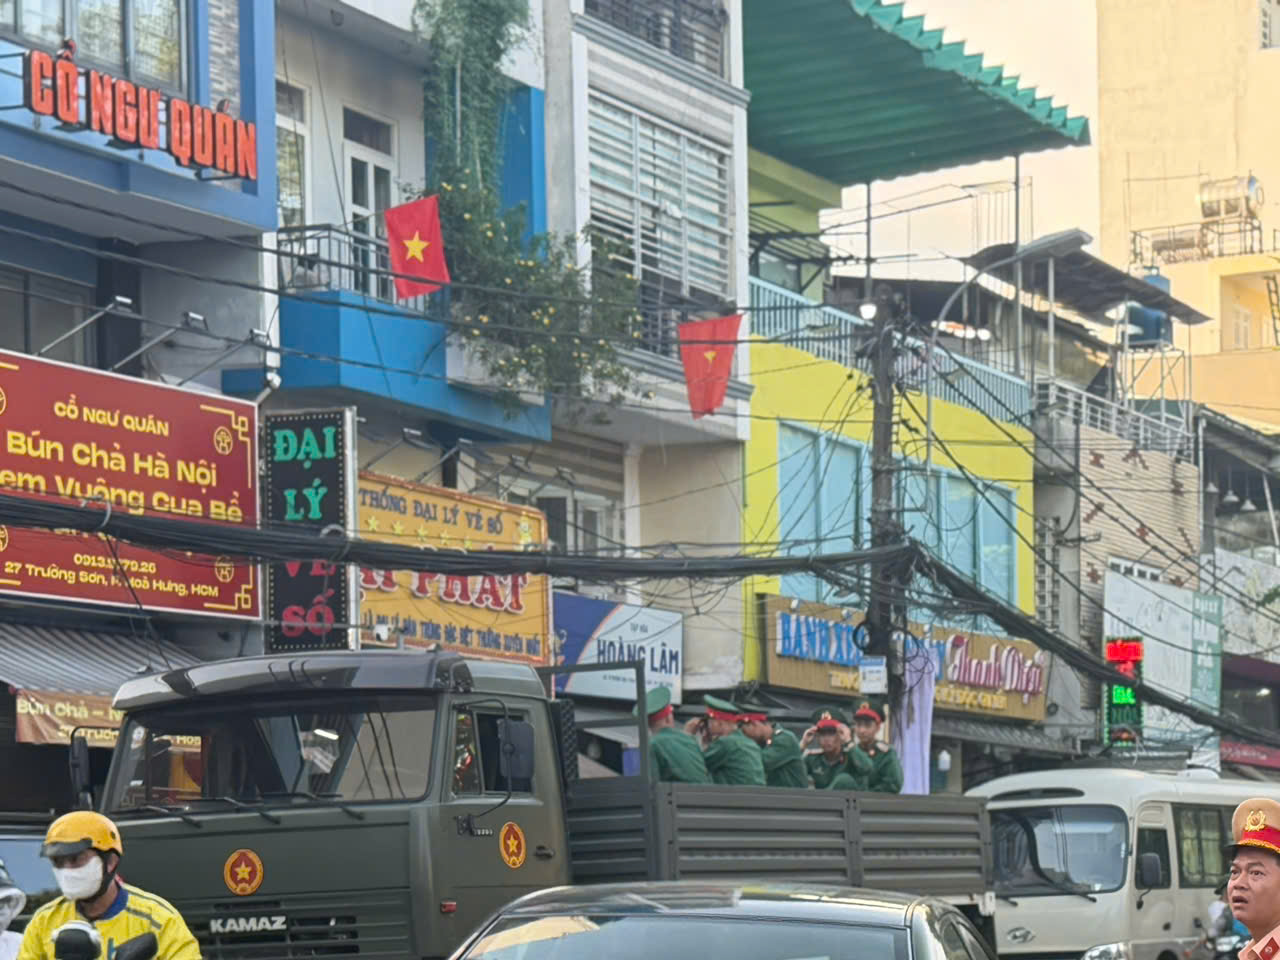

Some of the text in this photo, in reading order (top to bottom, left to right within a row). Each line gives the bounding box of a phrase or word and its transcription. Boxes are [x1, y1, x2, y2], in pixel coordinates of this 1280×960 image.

[31, 36, 258, 180] CỔ NGƯ QUÁN
[54, 393, 169, 437] CỔ NGƯ QUÁN
[7, 430, 217, 494] Bún Chả Hà Nội
[273, 426, 336, 469] ĐẠI
[151, 491, 203, 517] Cua
[209, 491, 243, 523] Bể
[283, 478, 328, 520] LÝ
[414, 499, 438, 522] ĐẠI
[444, 504, 459, 526] LÝ
[4, 561, 22, 575] 27
[25, 563, 76, 585] Trường
[191, 584, 219, 598] HCM
[282, 588, 335, 638] SỐ
[650, 642, 679, 675] LÂM
[210, 916, 287, 933] KAMAZ
